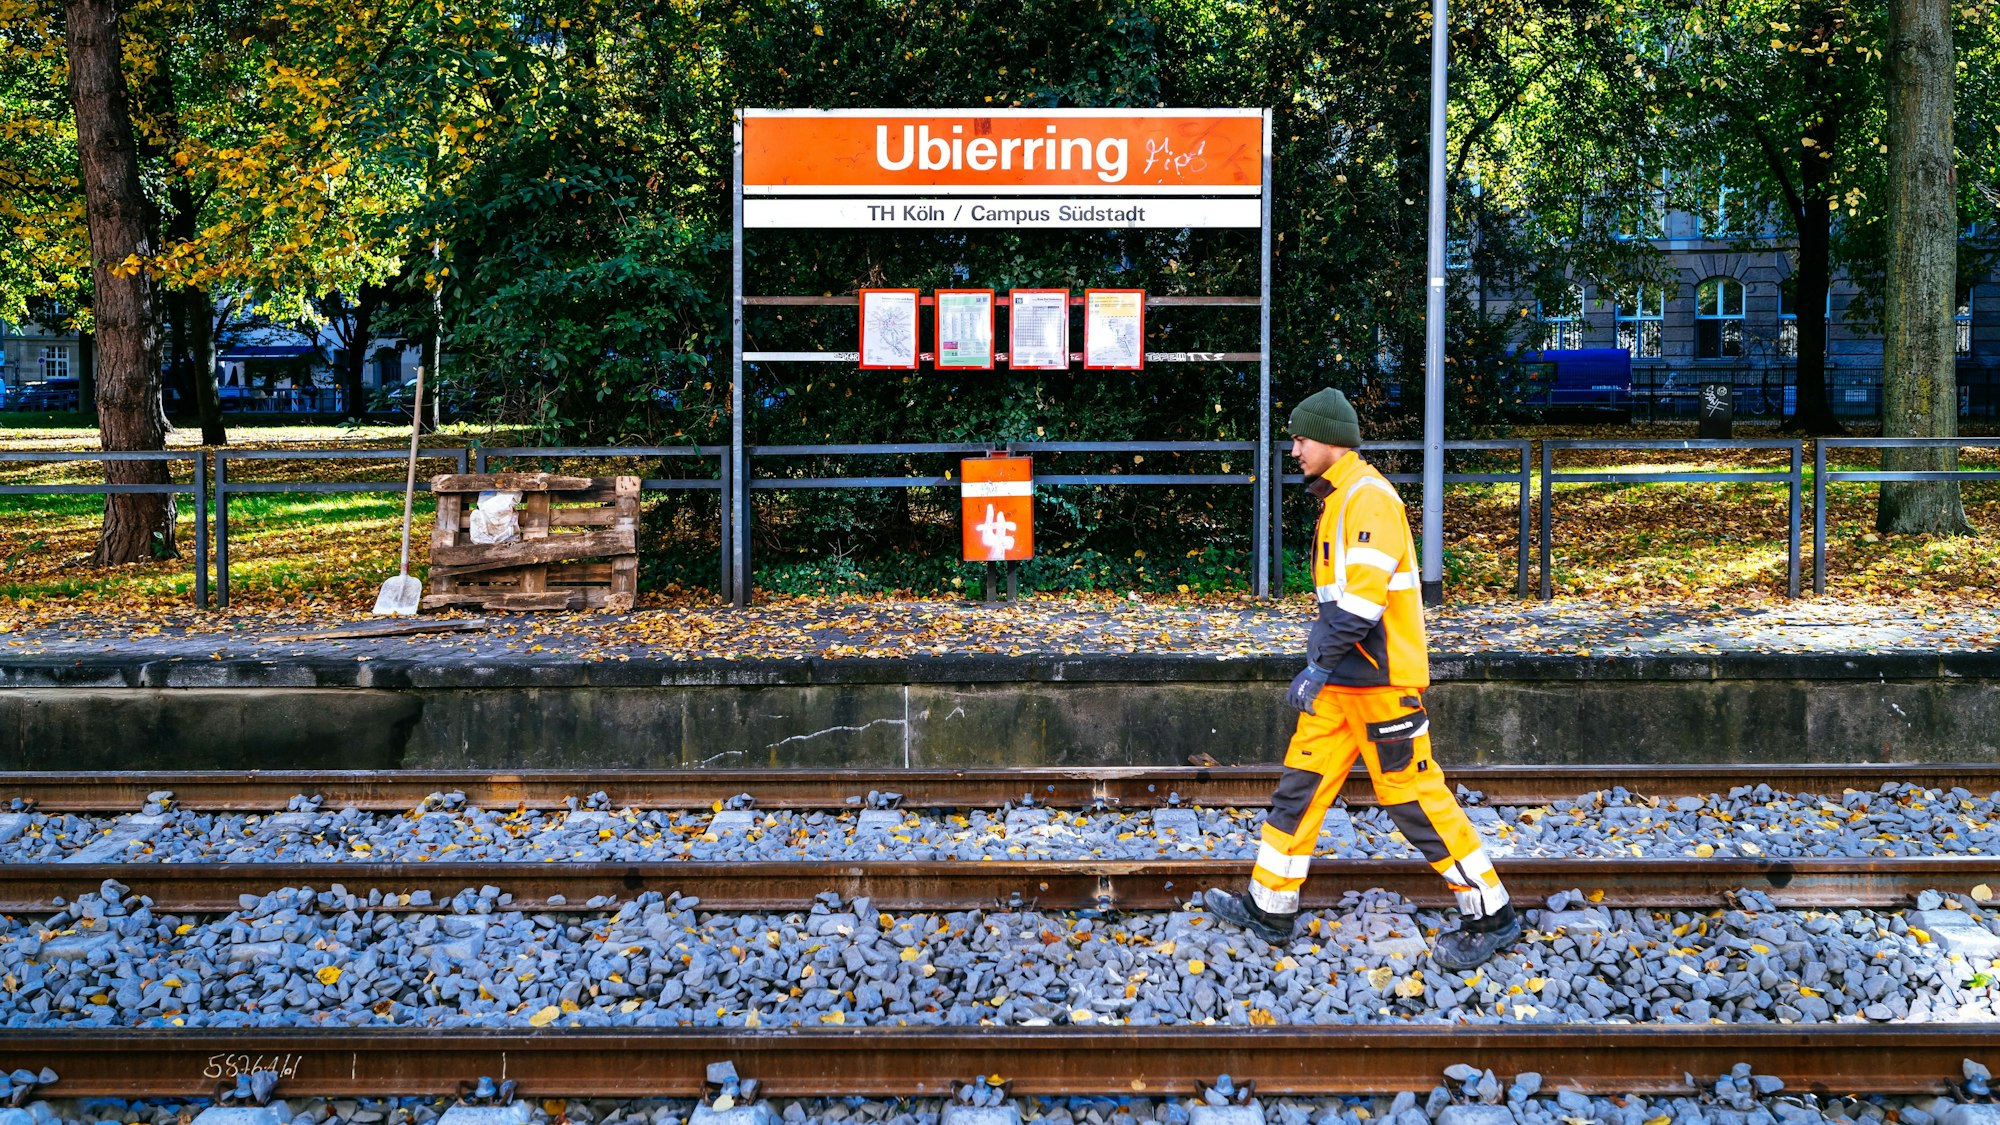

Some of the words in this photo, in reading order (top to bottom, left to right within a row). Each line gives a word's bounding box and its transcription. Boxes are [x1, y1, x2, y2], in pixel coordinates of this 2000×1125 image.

[876, 125, 1128, 183] Ubierring
[867, 205, 895, 221] TH
[903, 205, 945, 221] Köln
[953, 204, 963, 222] /
[971, 205, 1050, 225] Campus
[1058, 205, 1146, 222] Südstadt
